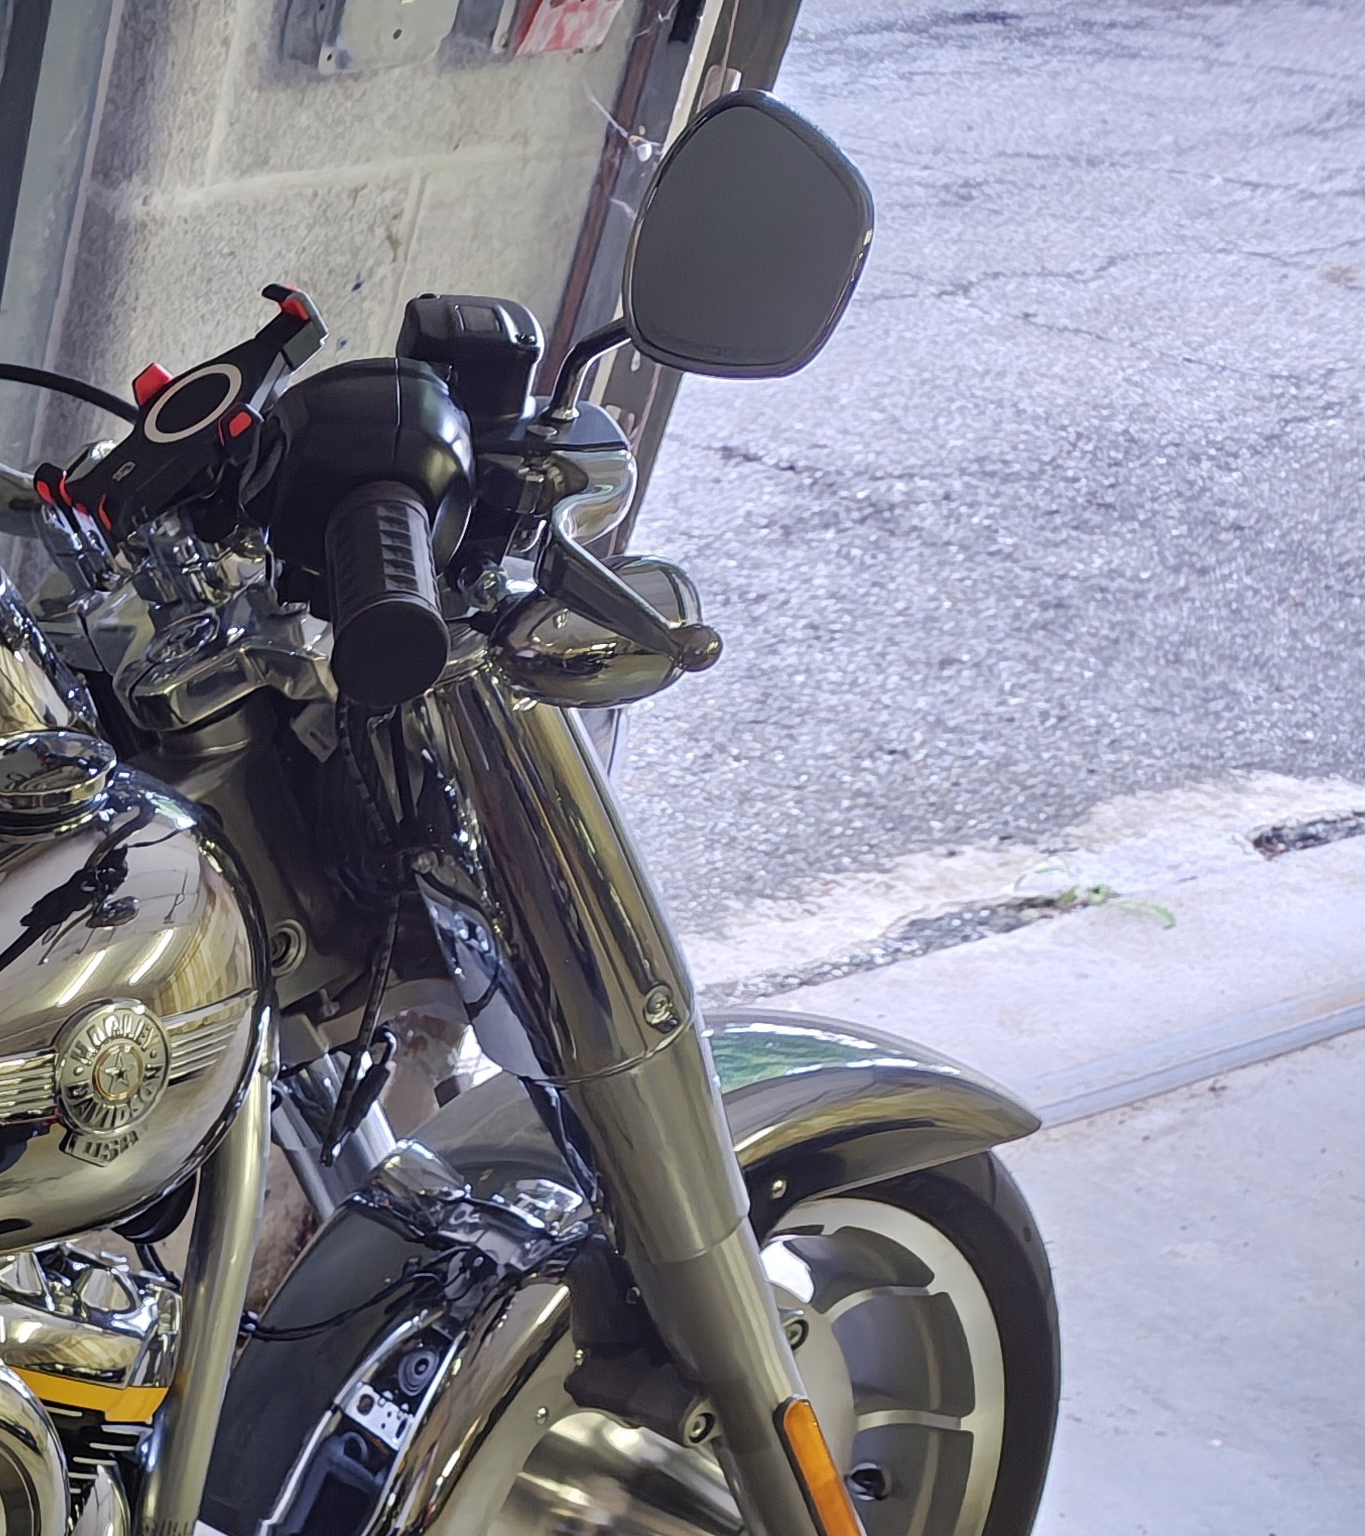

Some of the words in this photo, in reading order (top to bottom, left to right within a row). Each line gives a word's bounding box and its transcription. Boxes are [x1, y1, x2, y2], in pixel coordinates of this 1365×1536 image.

[70, 1013, 157, 1066] HARLEY
[66, 1064, 162, 1129] DAVIDSON
[82, 1130, 139, 1162] USA
